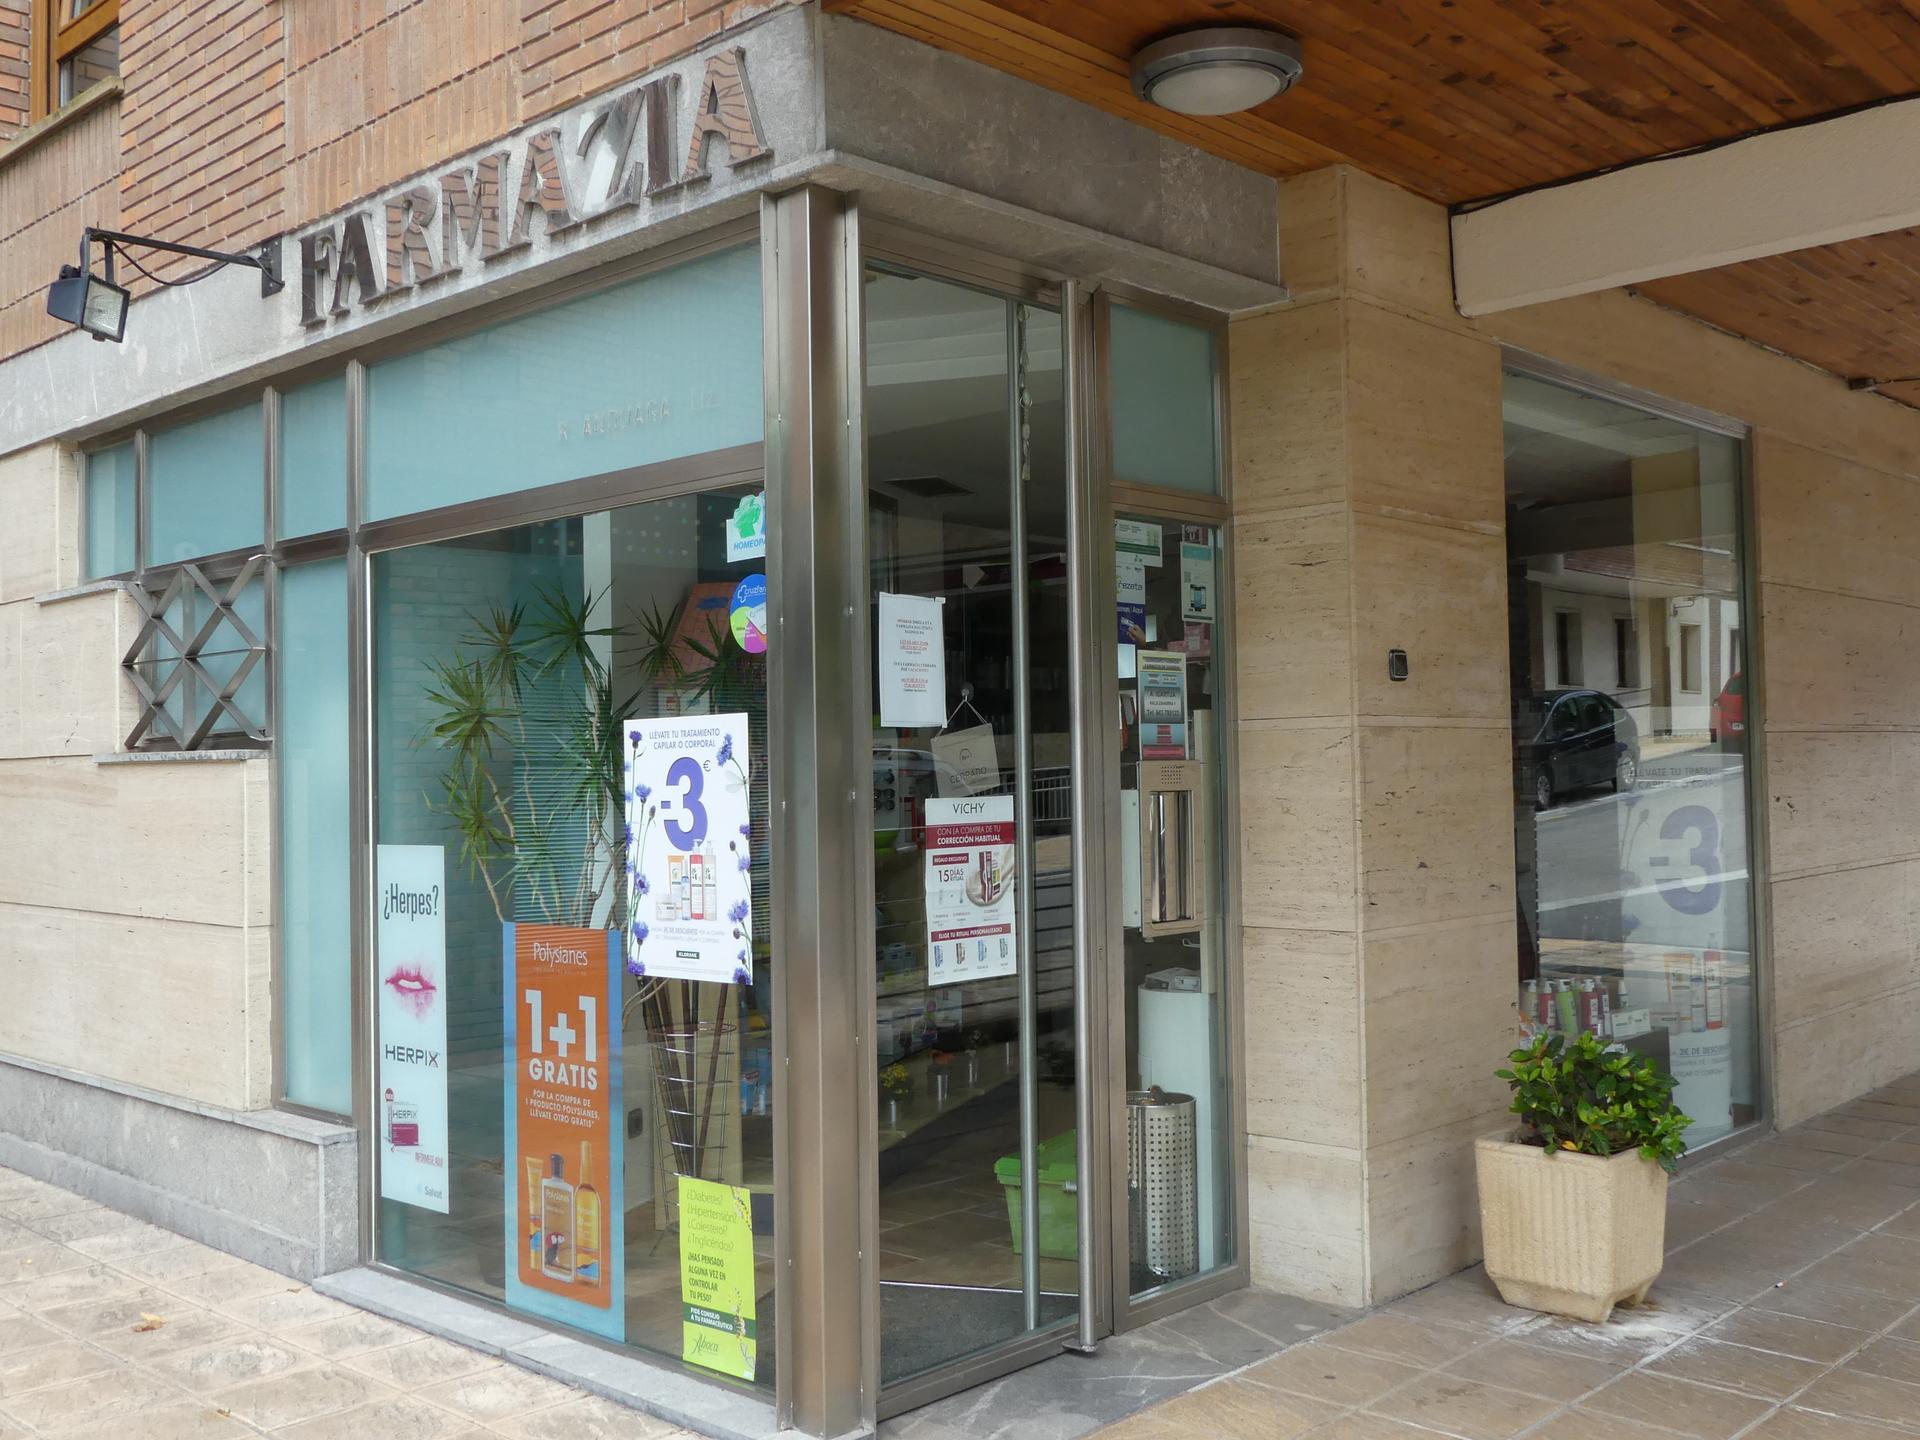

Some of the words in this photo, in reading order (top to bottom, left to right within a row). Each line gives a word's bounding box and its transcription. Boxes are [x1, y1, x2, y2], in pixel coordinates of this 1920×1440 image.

[300, 45, 774, 327] FARMAZIA
[672, 729, 679, 738] TU
[680, 727, 720, 738] TRATAMIENTO
[654, 741, 676, 750] CAPILAR
[677, 740, 684, 749] O
[684, 739, 716, 748] CORPORAL
[952, 803, 985, 814] VICHY
[937, 827, 952, 836] CON
[953, 827, 959, 835] LA
[960, 826, 984, 835] COMPRA
[985, 825, 993, 833] DE
[937, 835, 974, 845] CORRECCIÓN
[974, 834, 1001, 843] HABITUAL
[938, 869, 950, 883] 15
[384, 883, 439, 921] ¿Herpes?
[533, 942, 588, 968] Polysianes
[525, 989, 597, 1062] 1+1
[385, 1044, 439, 1068] HERPIX
[529, 1058, 598, 1091] GRATIS
[529, 1098, 561, 1112] PRODUCTO
[533, 1089, 545, 1098] POR
[546, 1091, 554, 1100] LA
[555, 1093, 581, 1105] COMPRA
[582, 1098, 592, 1108] DE
[553, 1112, 570, 1124] OTRO
[701, 1254, 725, 1268] PENSADO
[688, 1265, 709, 1277] ALGUNA
[709, 1267, 719, 1280] VEZ
[719, 1270, 727, 1281] EN
[688, 1277, 718, 1292] CONTROLAR
[690, 1289, 698, 1299] TU
[697, 1291, 712, 1303] PESO?
